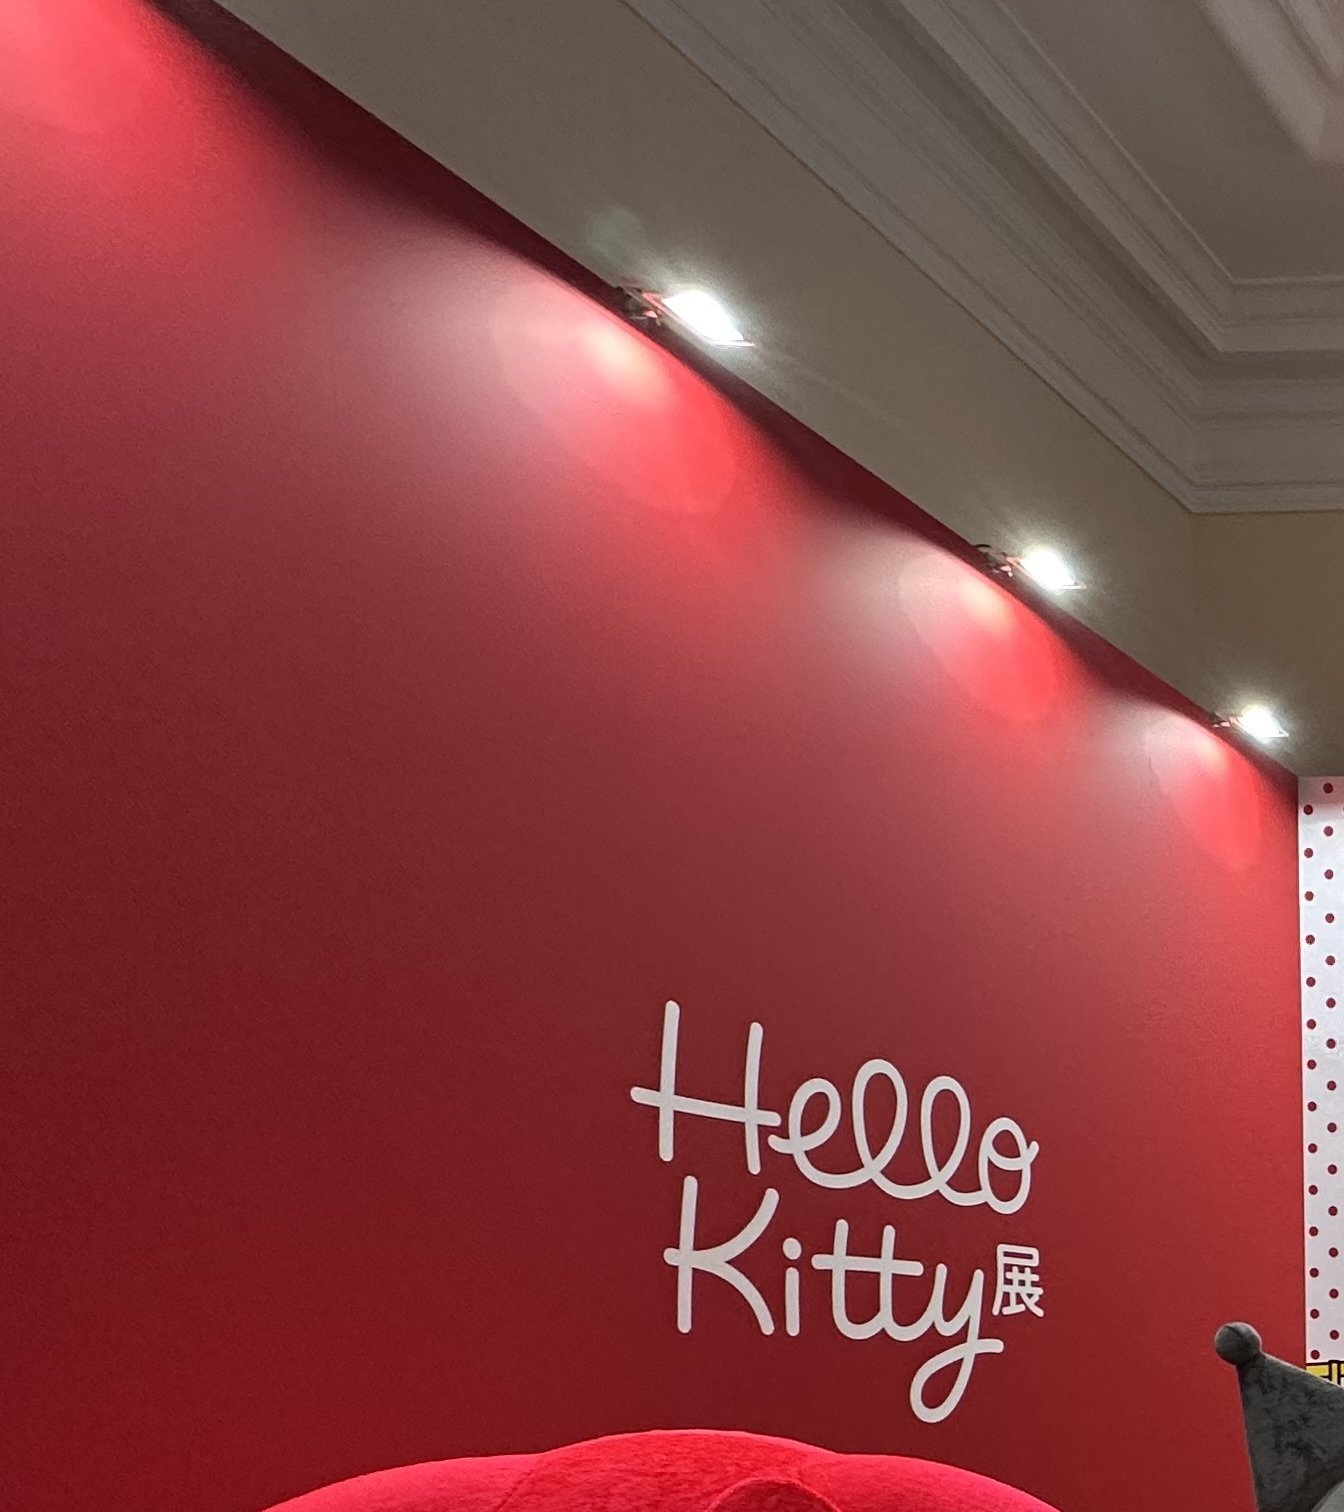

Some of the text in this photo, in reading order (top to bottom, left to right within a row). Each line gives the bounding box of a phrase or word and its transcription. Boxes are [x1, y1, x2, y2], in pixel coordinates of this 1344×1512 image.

[630, 1000, 1039, 1214] Hello
[663, 1175, 1044, 1423] Kitty 展
